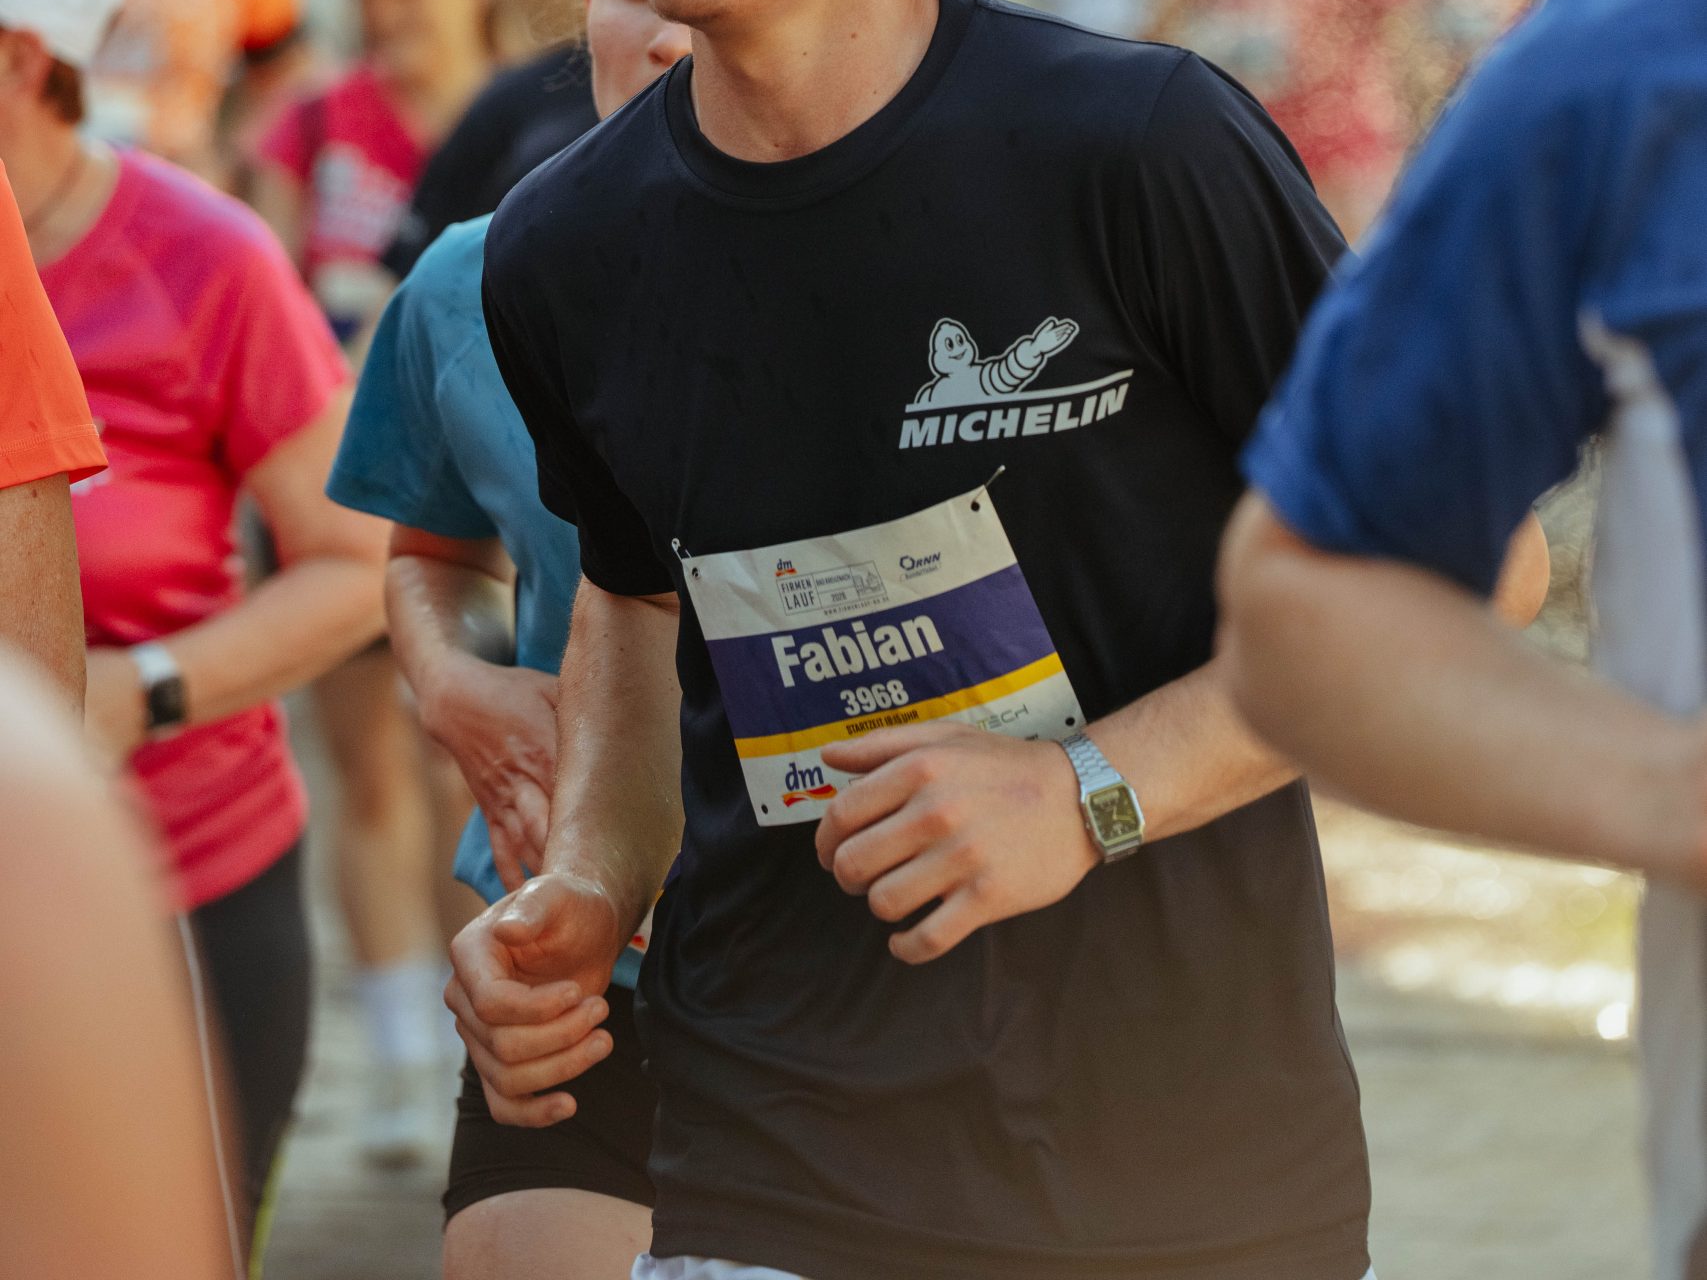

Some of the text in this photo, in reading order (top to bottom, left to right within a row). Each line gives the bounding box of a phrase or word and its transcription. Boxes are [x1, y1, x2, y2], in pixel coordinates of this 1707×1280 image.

[899, 383, 1130, 449] MICHELIN
[776, 558, 793, 571] dm
[781, 577, 813, 593] FIRMEN
[784, 590, 816, 610] LAUF
[770, 614, 945, 688] Fabian
[840, 679, 910, 717] 3968
[846, 717, 884, 735] STARTZEIT
[901, 709, 920, 724] UHR
[785, 762, 825, 791] dm
